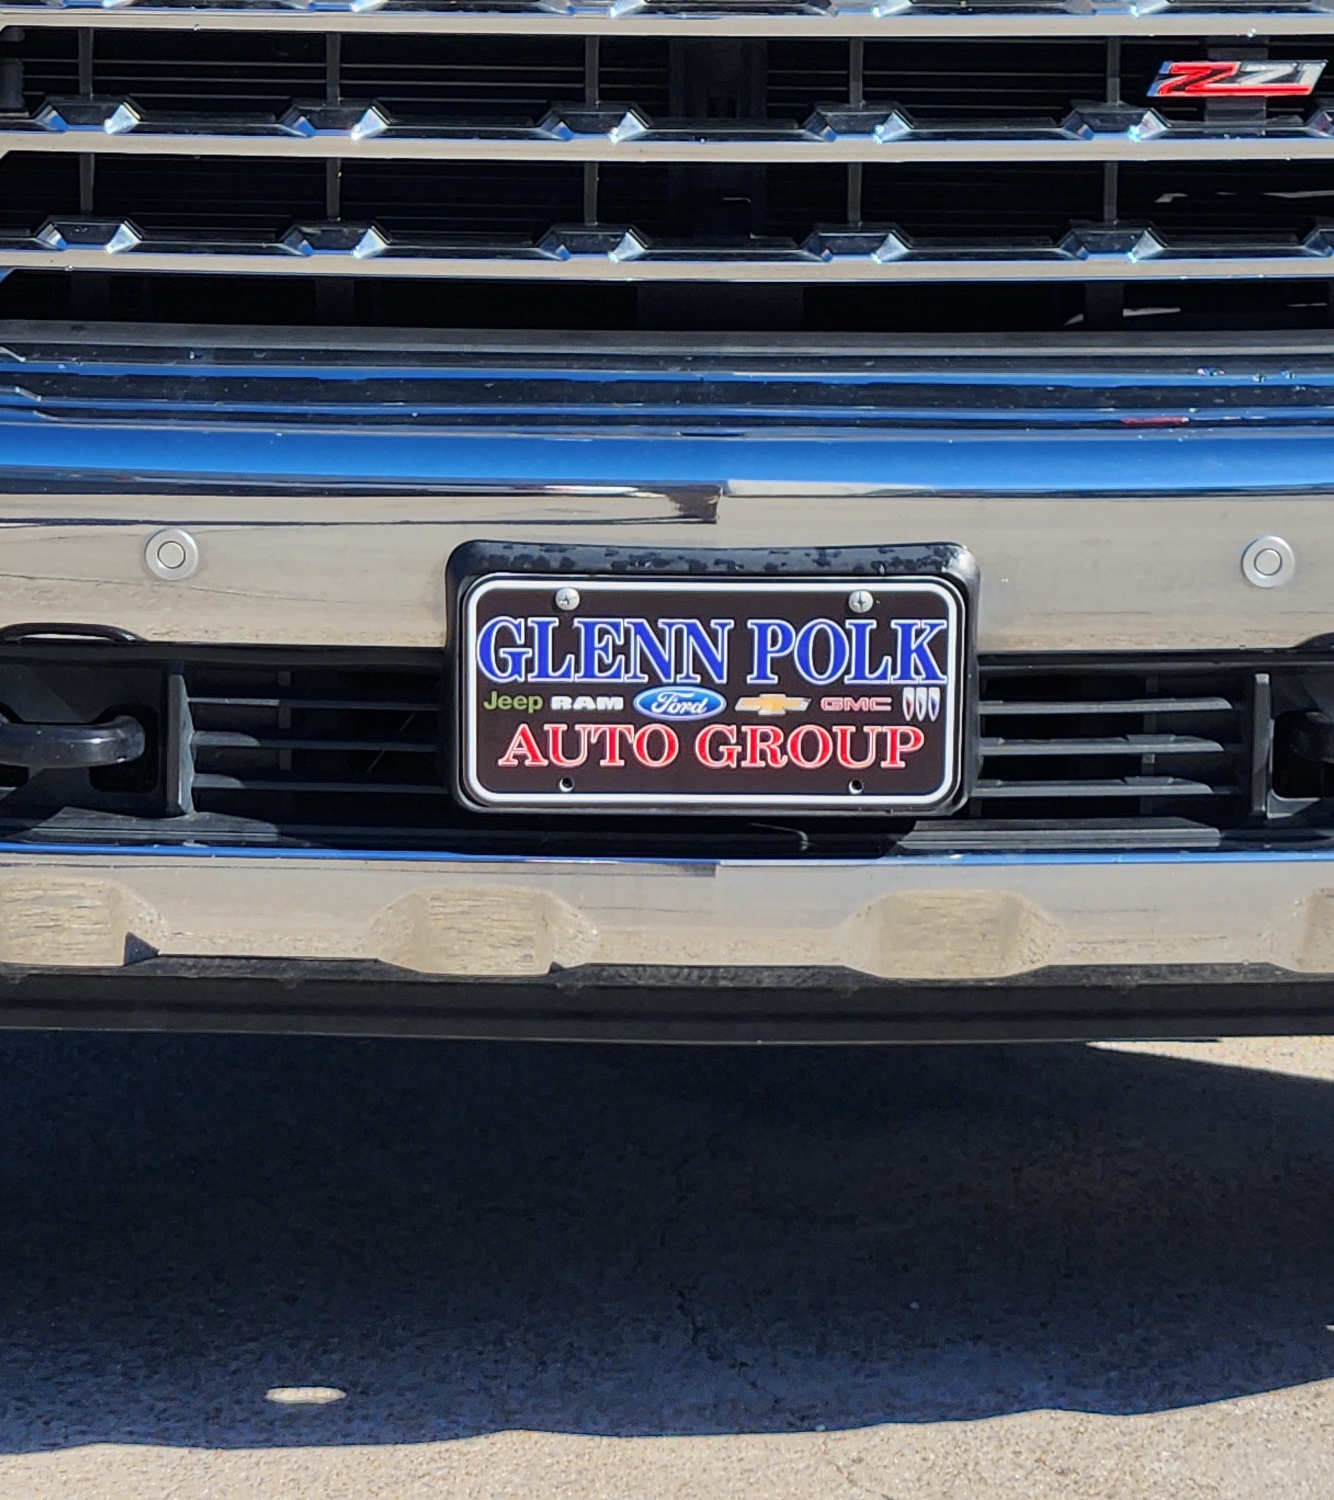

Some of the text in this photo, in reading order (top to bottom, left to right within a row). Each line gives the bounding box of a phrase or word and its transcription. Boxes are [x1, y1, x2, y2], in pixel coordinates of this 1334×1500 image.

[1147, 59, 1329, 98] Z71
[476, 615, 947, 685] GLENN POLK
[483, 691, 893, 717] Jeep RAM Ford GMC
[498, 722, 925, 769] AUTO GROUP
